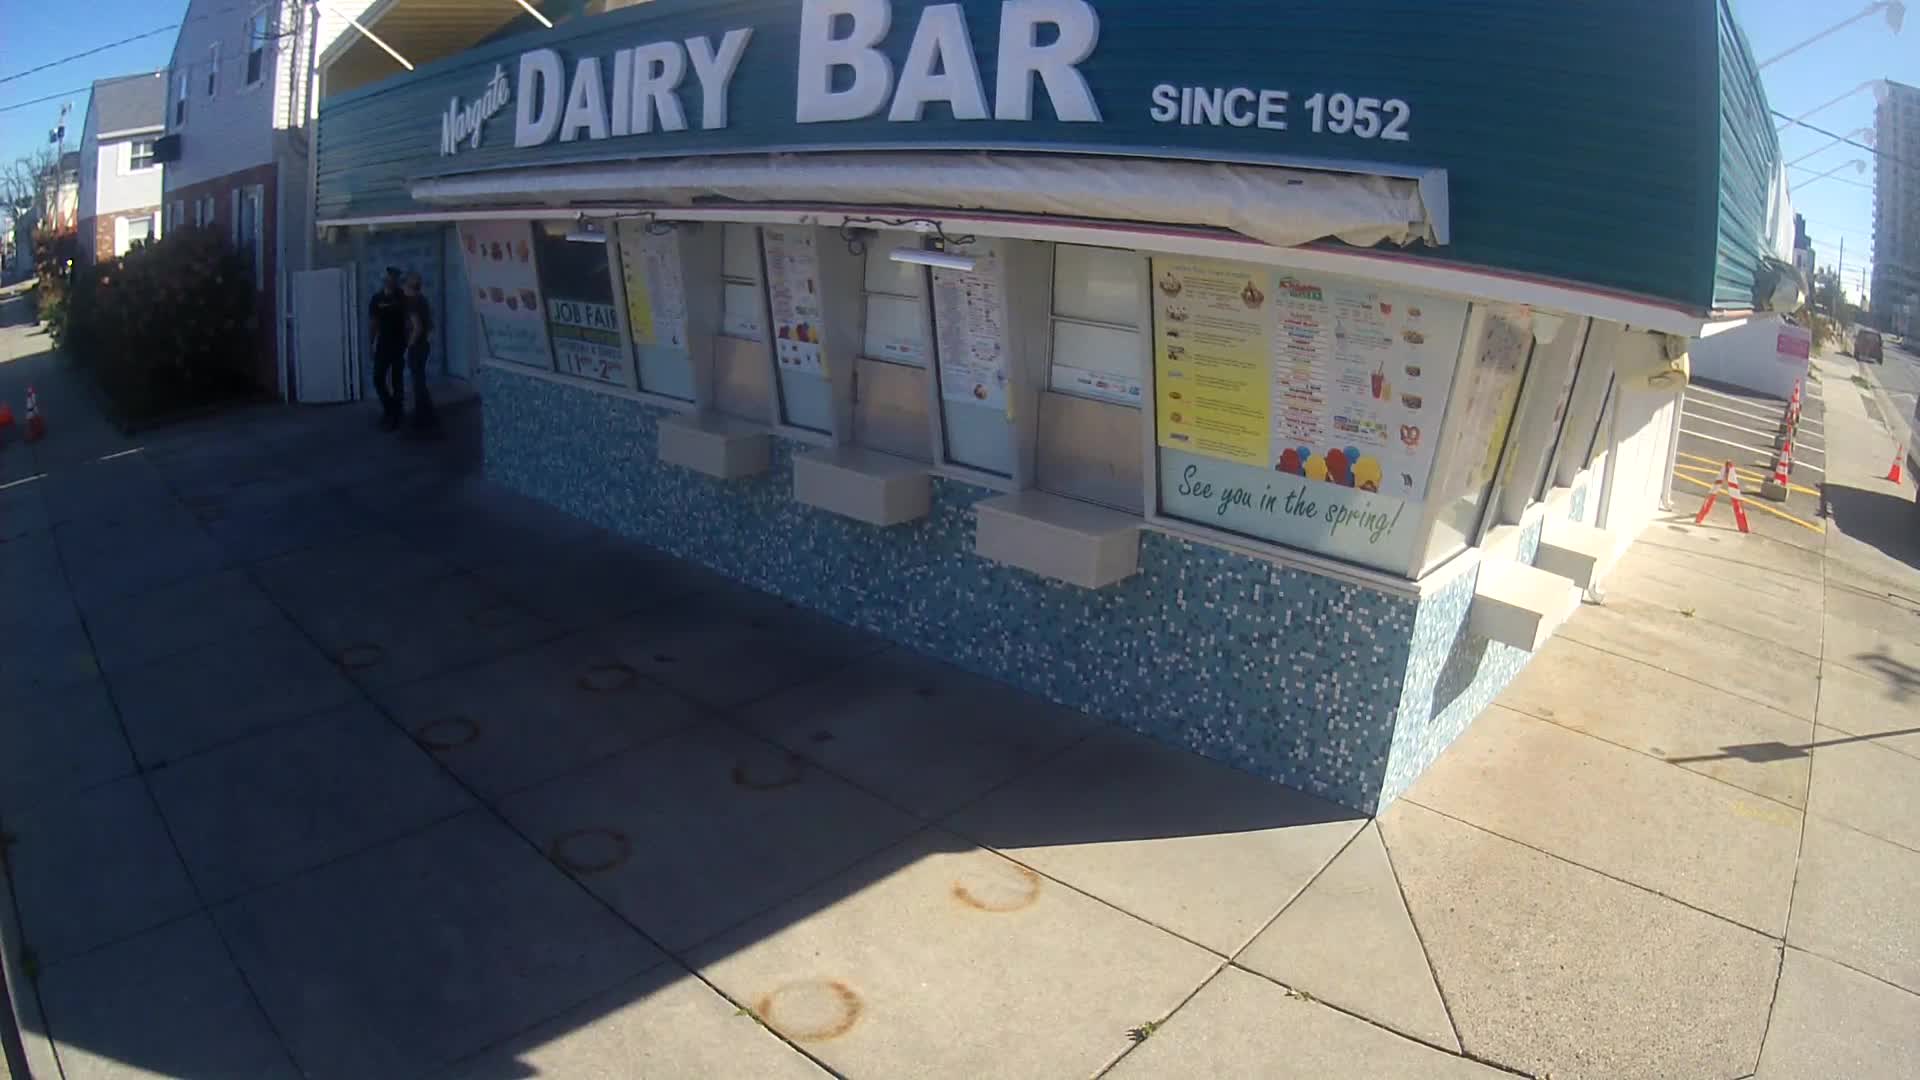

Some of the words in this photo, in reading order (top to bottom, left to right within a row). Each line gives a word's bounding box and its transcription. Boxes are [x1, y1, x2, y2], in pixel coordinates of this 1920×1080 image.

[440, 64, 511, 157] Margate
[514, 27, 755, 148] DAIRY
[795, 0, 1104, 123] BAR
[1150, 84, 1288, 130] SINCE
[1304, 92, 1411, 141] 1952
[554, 302, 581, 323] JOB
[1178, 464, 1213, 498] See
[1217, 487, 1252, 516] you
[1259, 484, 1278, 512] in
[1284, 485, 1318, 519] the
[1325, 500, 1404, 544] spring!
